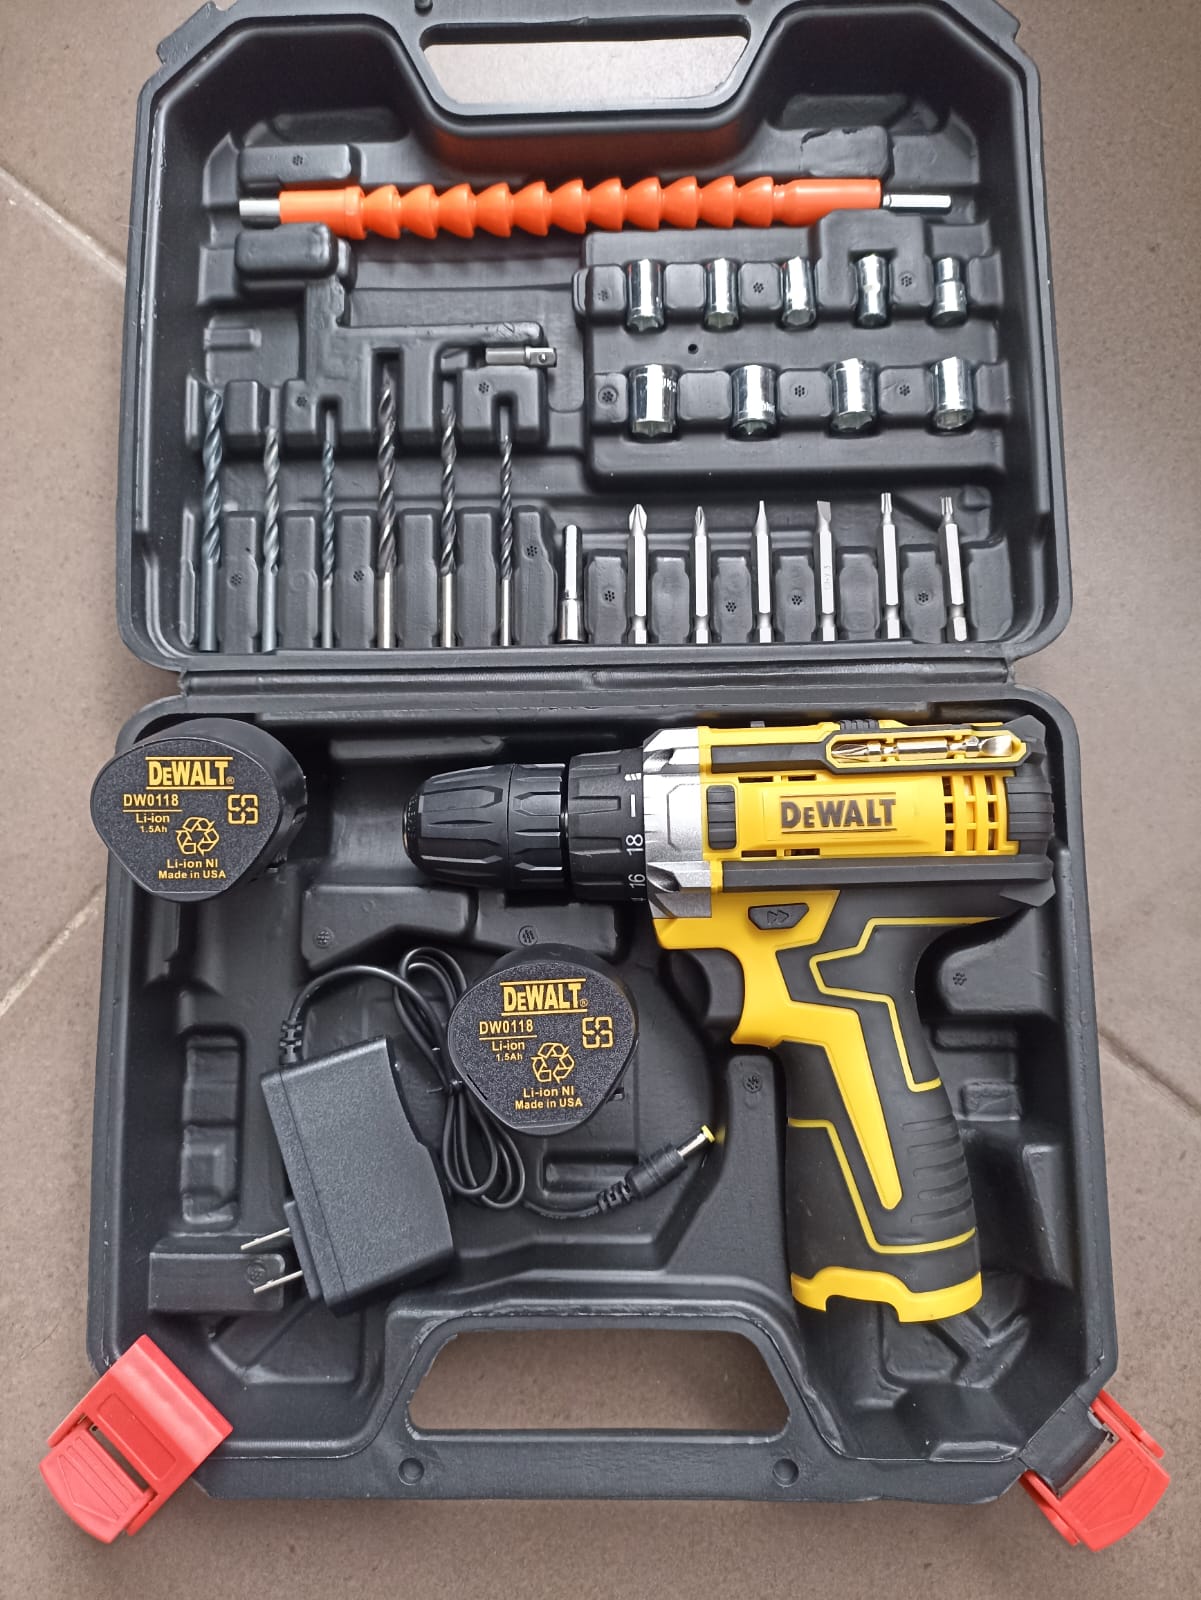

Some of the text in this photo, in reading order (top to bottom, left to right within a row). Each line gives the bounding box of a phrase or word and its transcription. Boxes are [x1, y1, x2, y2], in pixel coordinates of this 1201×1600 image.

[122, 793, 179, 807] DW0118
[135, 813, 170, 823] Li-ion
[140, 825, 168, 833] 1.5Ah
[625, 833, 644, 856] 18
[166, 859, 202, 868] Li-ion
[158, 869, 226, 879] Made in USA
[628, 873, 646, 889] 16
[479, 1019, 534, 1035] DW0118
[491, 1041, 526, 1052] Li-ion
[496, 1053, 523, 1062] 1.5Ah
[523, 1087, 559, 1098] Li-ion
[515, 1097, 583, 1110] Made in USA
